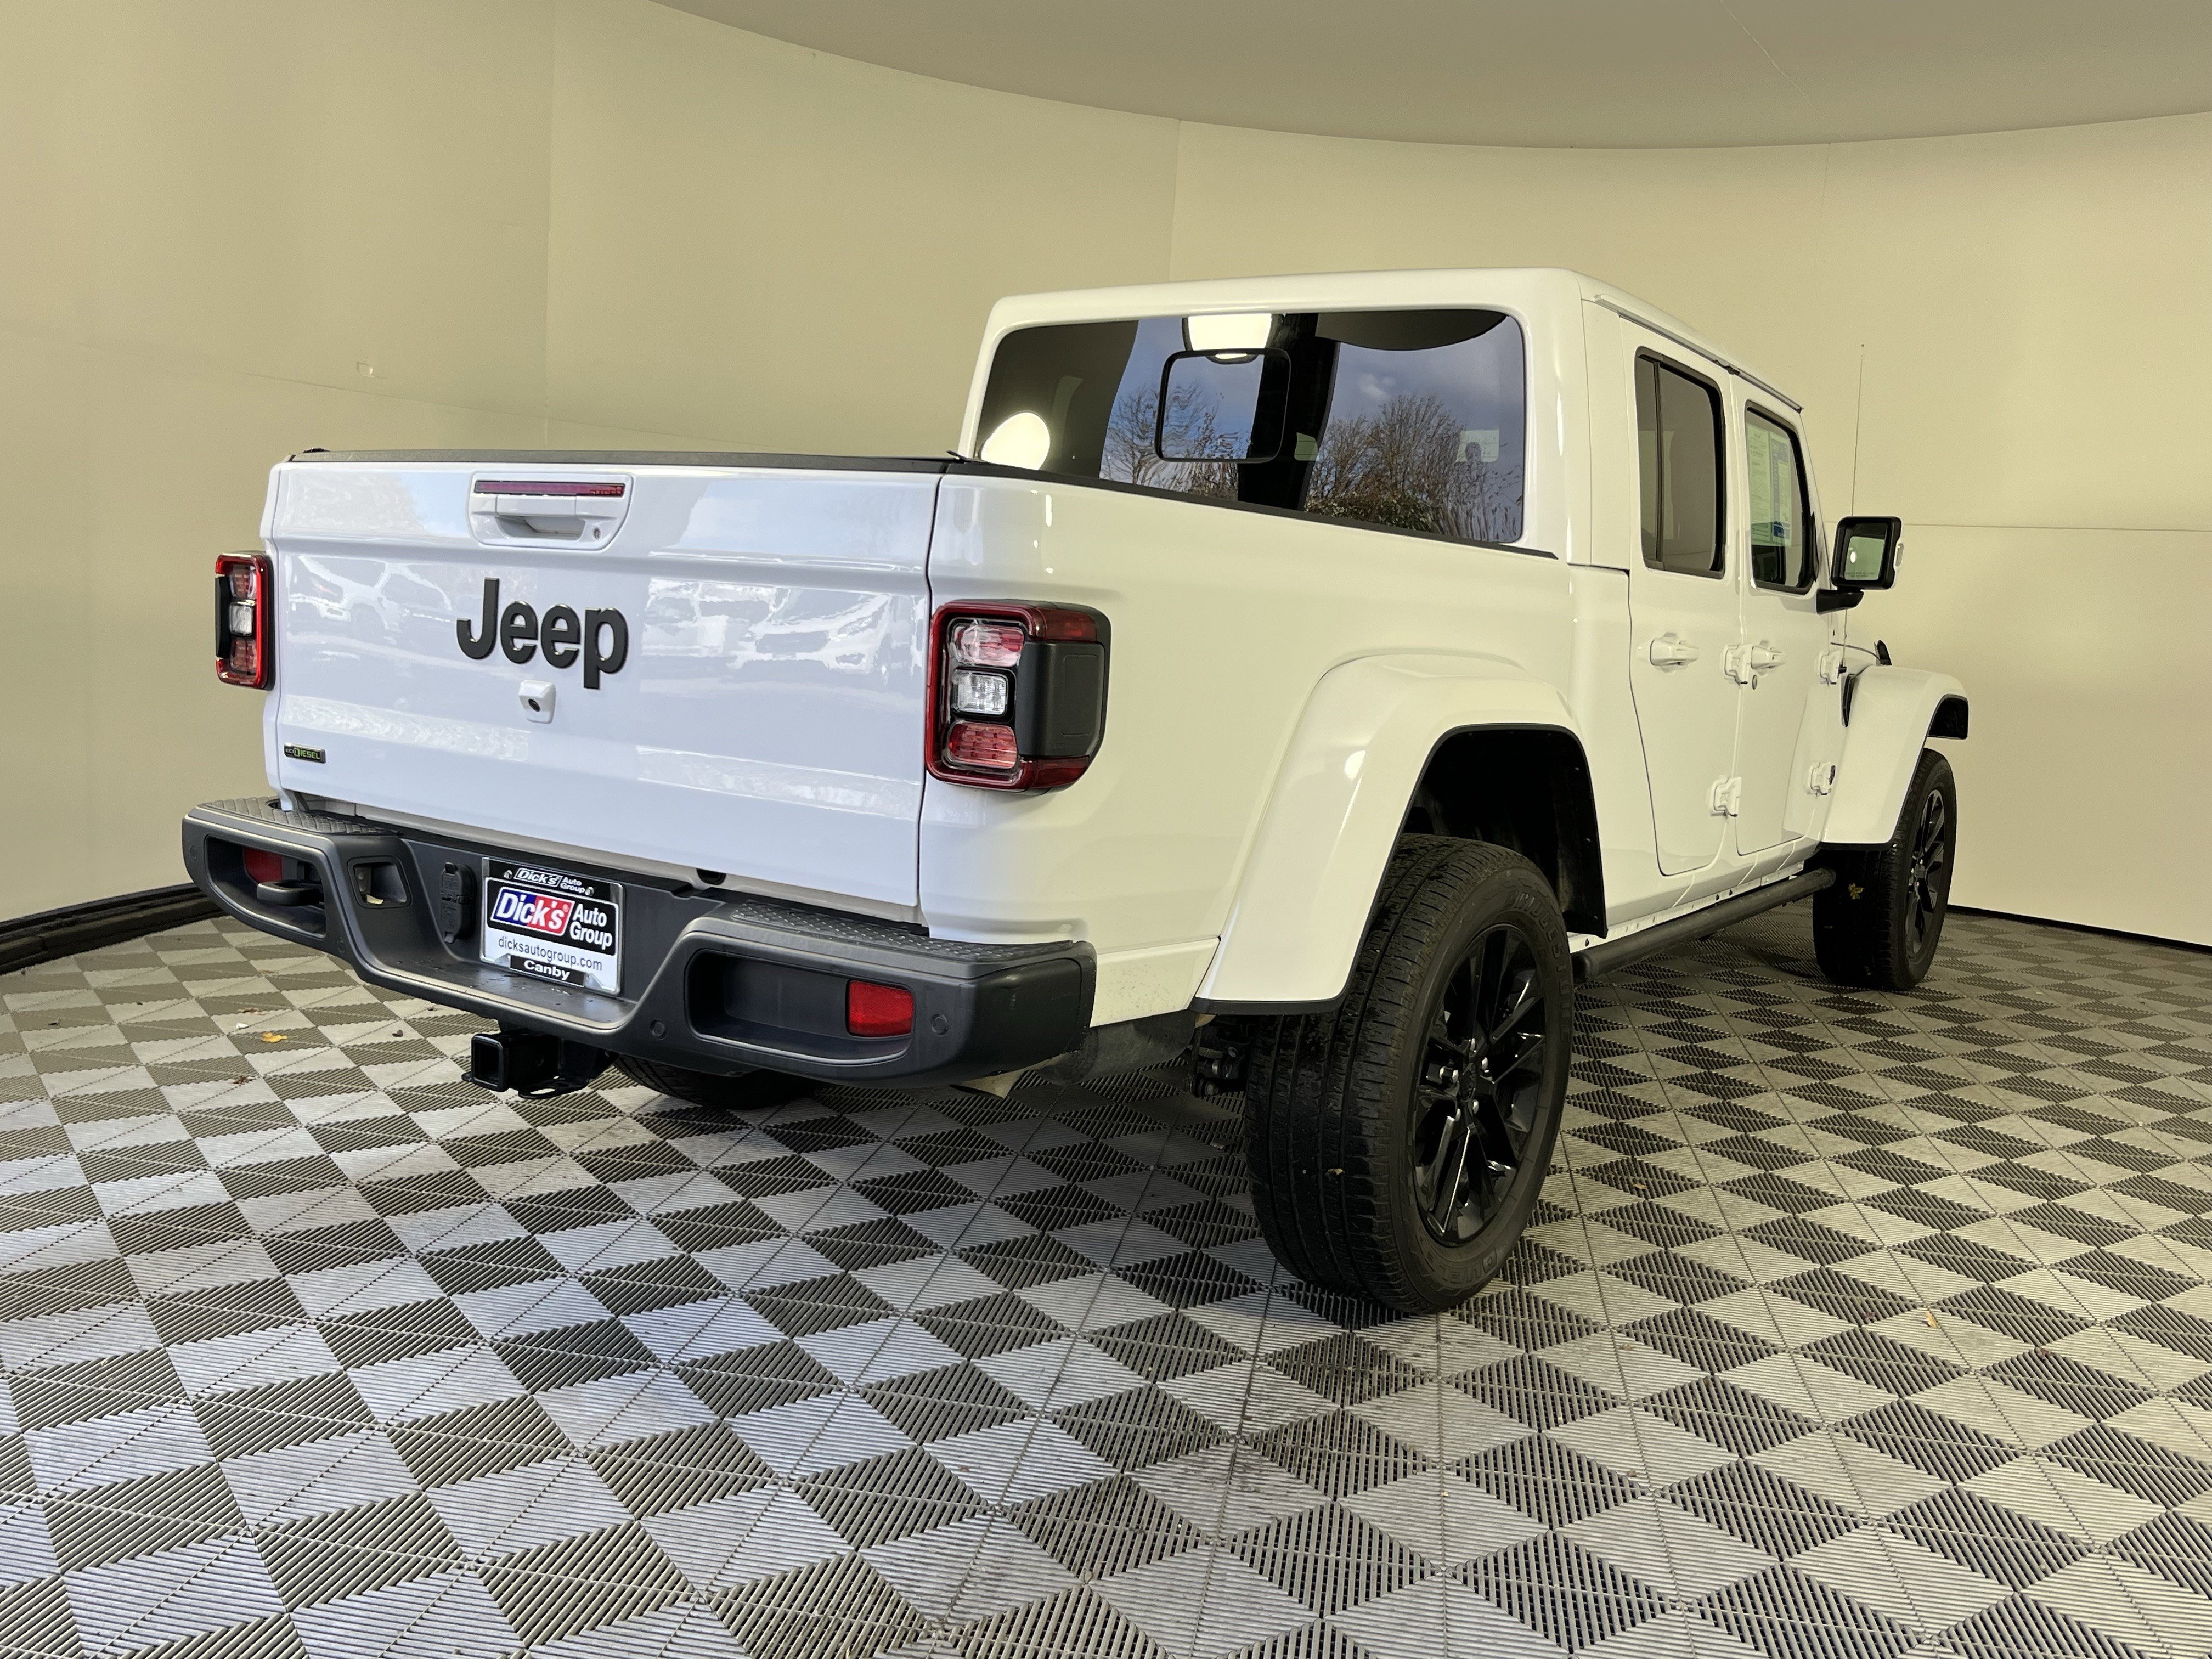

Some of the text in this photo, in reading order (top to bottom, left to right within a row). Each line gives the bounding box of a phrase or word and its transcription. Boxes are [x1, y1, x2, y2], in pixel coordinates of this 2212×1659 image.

[456, 577, 629, 690] Jeep
[560, 883, 585, 894] Group
[561, 876, 582, 886] Auto
[496, 892, 607, 930] Dick's Auto
[569, 921, 613, 950] Group
[498, 936, 603, 971] dicksautogroup.com
[523, 960, 571, 981] Canby
